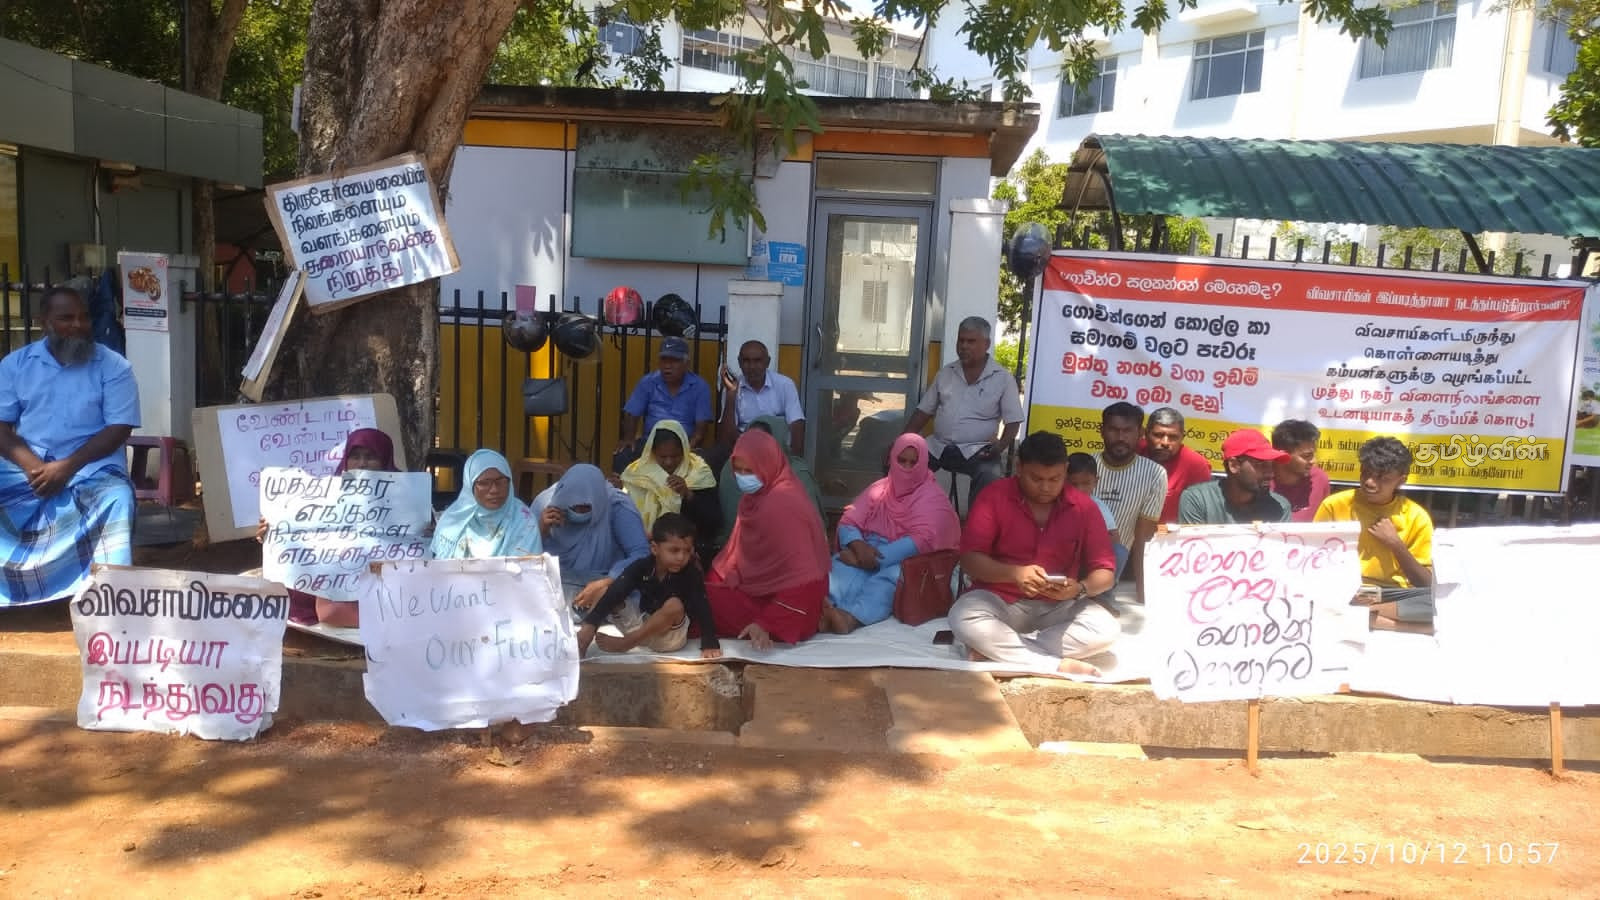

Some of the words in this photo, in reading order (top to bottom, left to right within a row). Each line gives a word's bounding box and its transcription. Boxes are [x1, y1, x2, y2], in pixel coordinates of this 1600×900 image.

[78, 580, 289, 621] விவசாயிகளை
[429, 580, 497, 613] Want
[425, 633, 476, 671] Our
